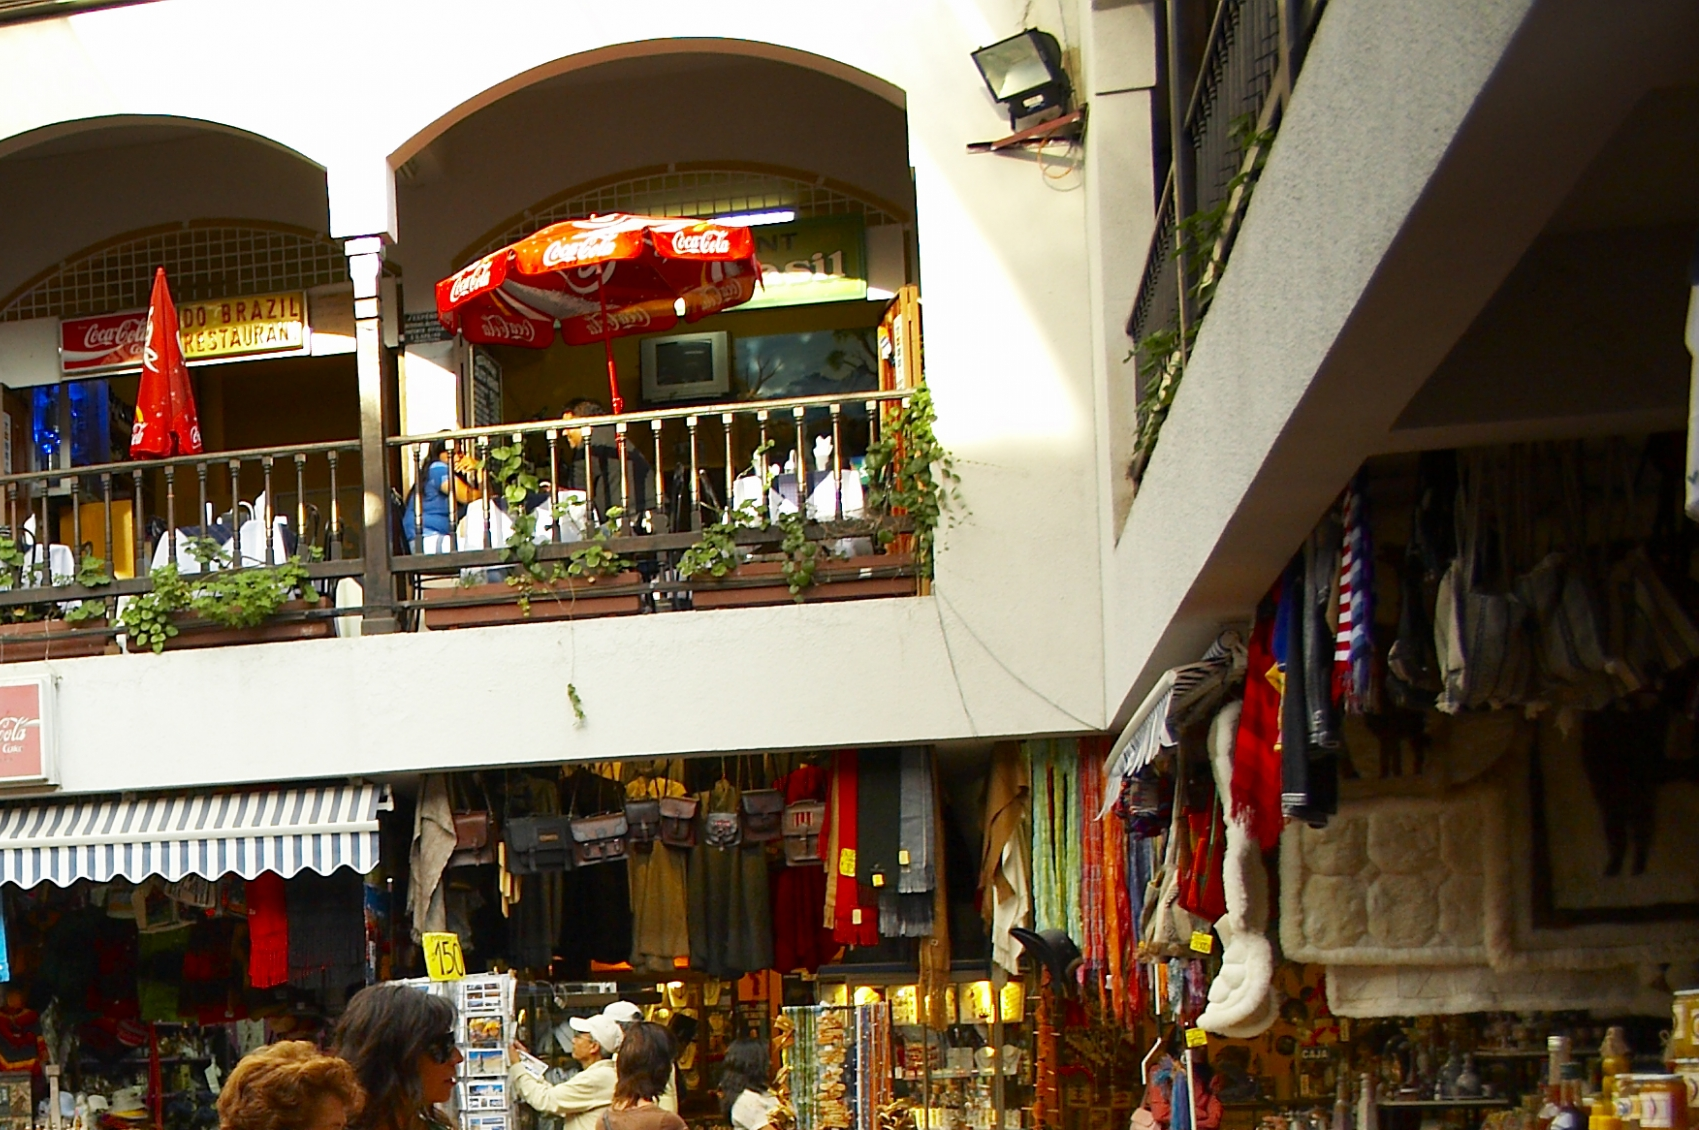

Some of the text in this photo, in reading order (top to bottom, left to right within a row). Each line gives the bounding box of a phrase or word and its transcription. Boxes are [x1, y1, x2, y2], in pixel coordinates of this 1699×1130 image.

[672, 230, 729, 255] Coca-Cola
[221, 297, 299, 324] BRAZIL
[183, 322, 299, 354] RESTAURAN
[1302, 1050, 1328, 1059] CAJA
